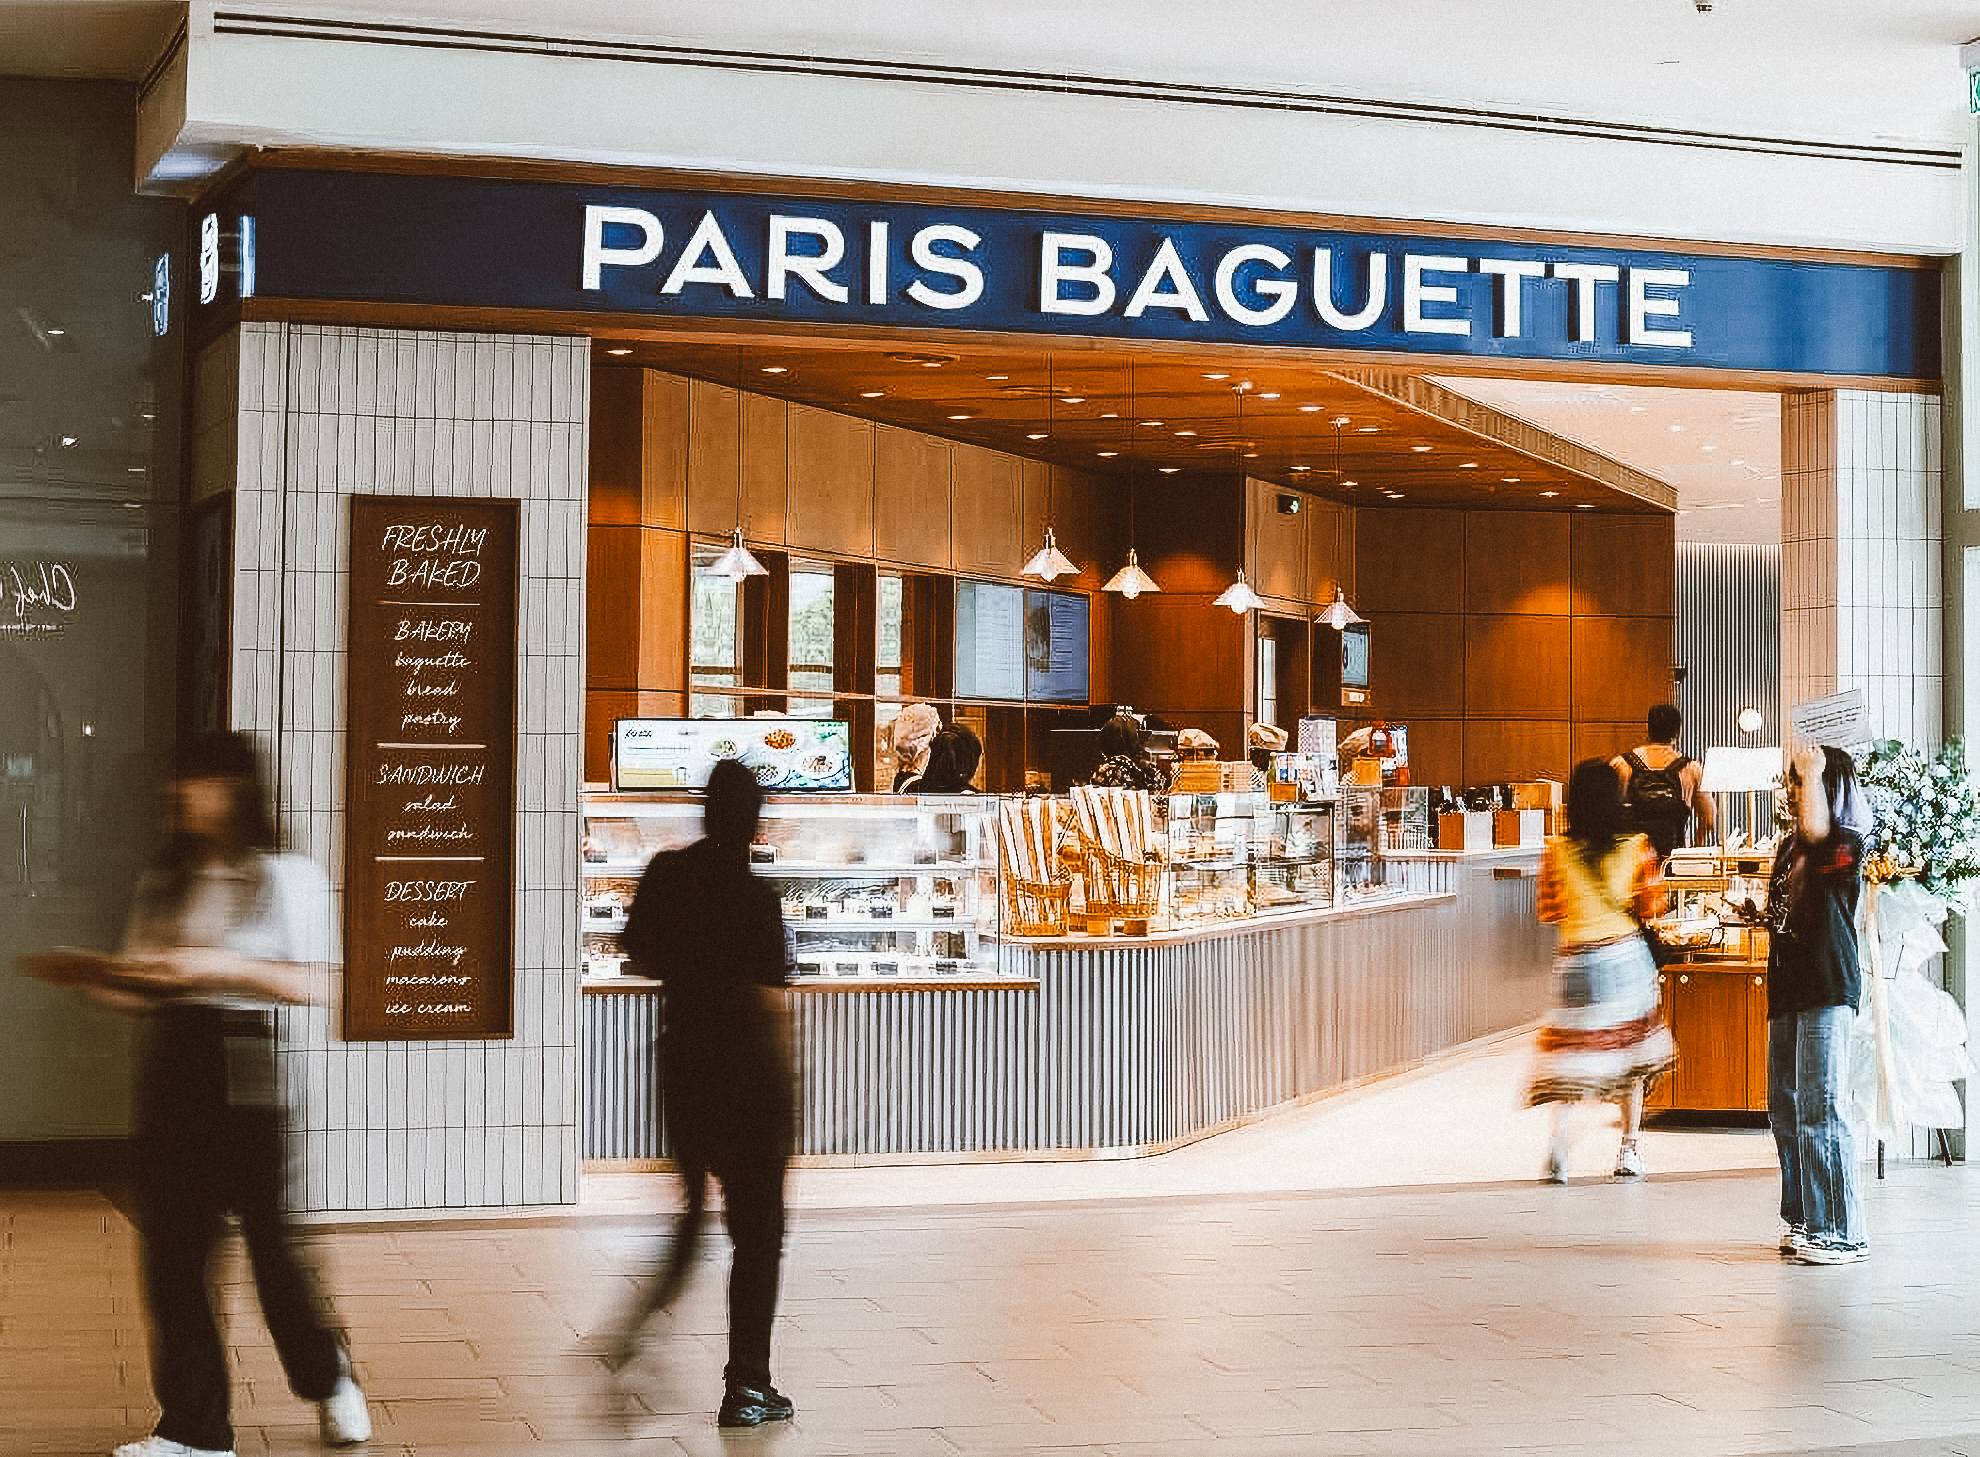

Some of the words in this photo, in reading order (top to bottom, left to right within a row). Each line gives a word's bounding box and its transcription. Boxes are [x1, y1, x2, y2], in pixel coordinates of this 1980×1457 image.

[582, 205, 985, 310] PARIS
[1038, 230, 1692, 349] BAGUETTE
[381, 524, 487, 556] FRESHLY
[386, 558, 481, 587] BAKED
[394, 620, 473, 643] BAKERY
[395, 651, 472, 675] baguette
[406, 680, 458, 697] bread
[377, 764, 485, 785] SANDWICH
[383, 880, 477, 901] DESSERT
[408, 910, 449, 927] cake
[390, 938, 467, 965] pudding
[385, 1002, 412, 1014] ice
[417, 1003, 472, 1014] cream
